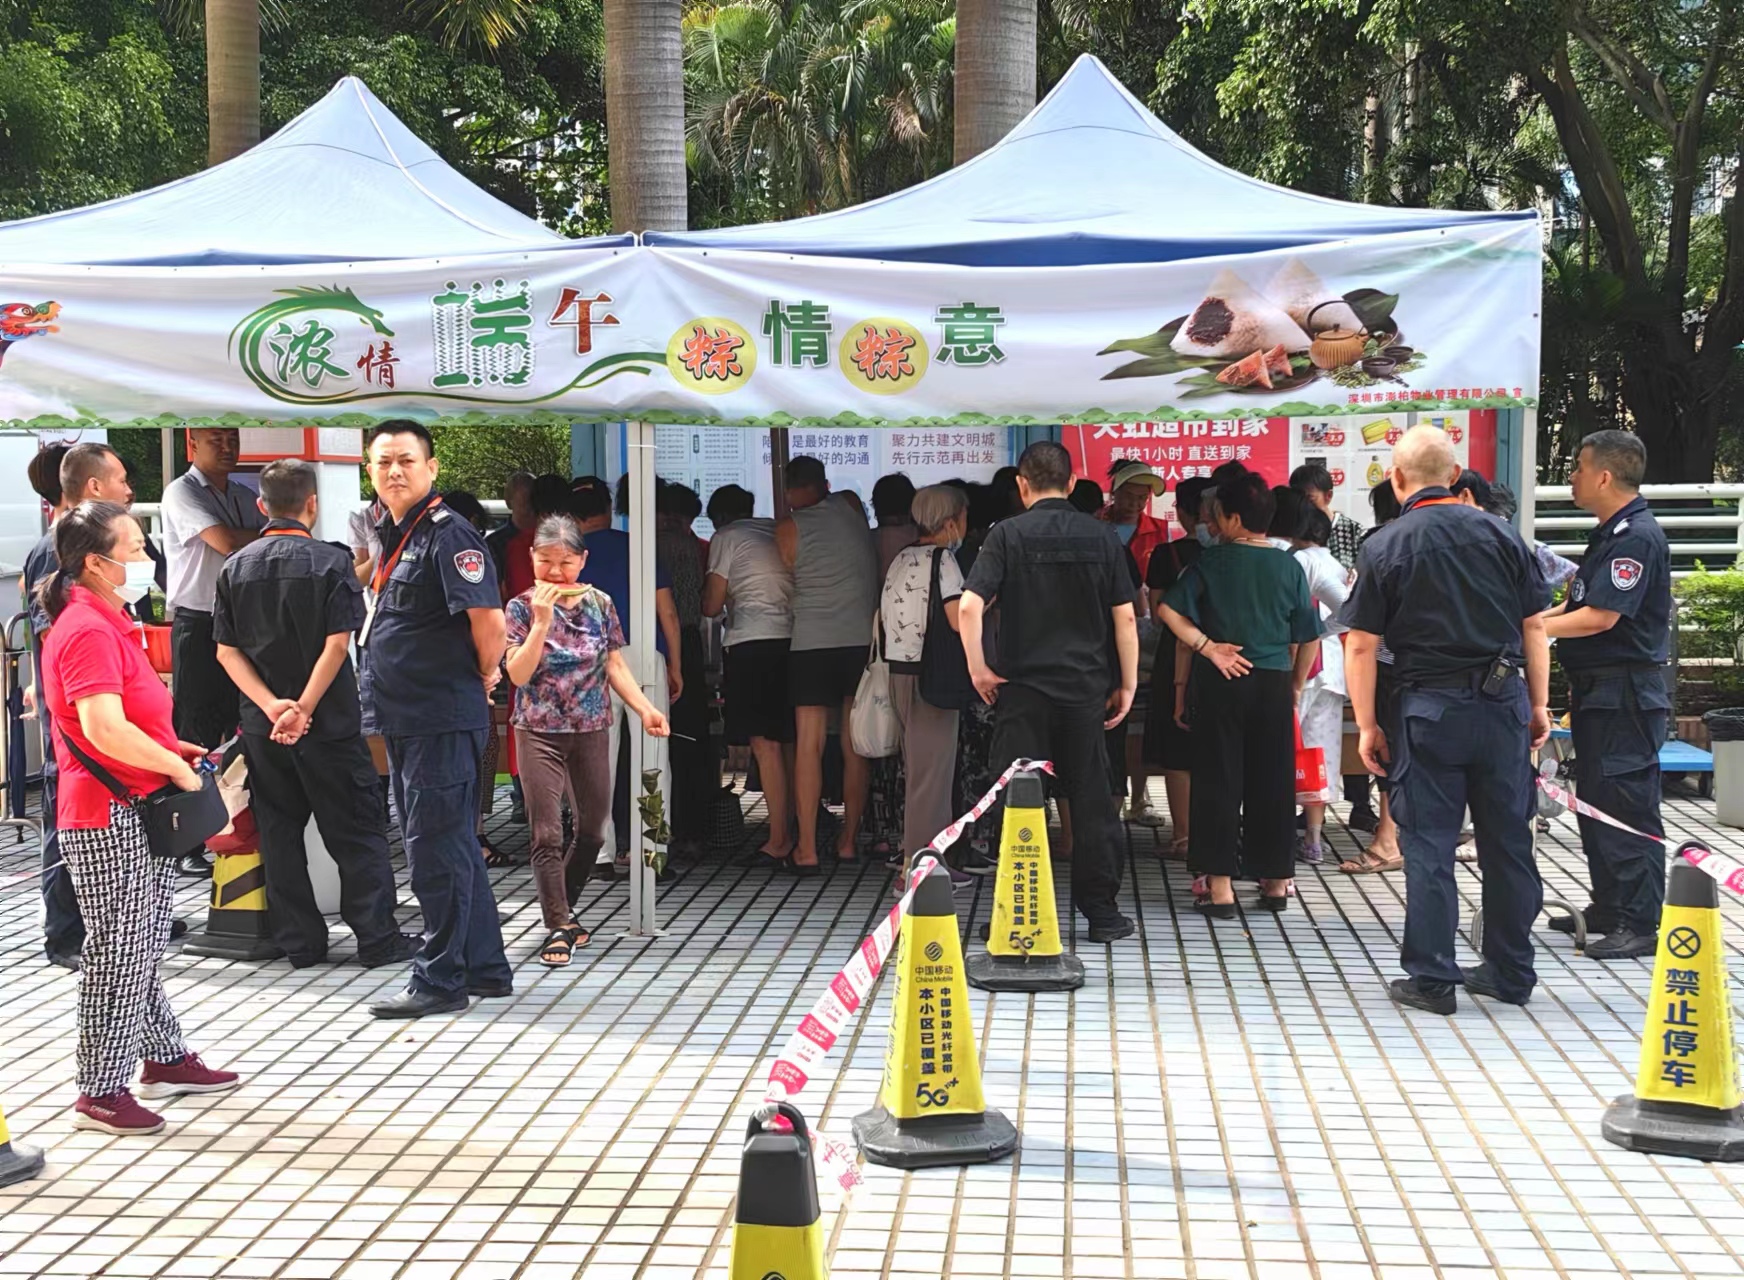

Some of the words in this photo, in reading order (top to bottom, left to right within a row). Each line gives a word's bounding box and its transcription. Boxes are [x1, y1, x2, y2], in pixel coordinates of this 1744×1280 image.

[762, 434, 869, 448] 陪是最好的教育
[891, 433, 996, 447] 聚力共建文明城
[891, 451, 995, 465] 先行示范再出发
[1110, 445, 1183, 462] 最快1小时
[1187, 445, 1252, 461] 直送到家
[914, 965, 954, 976] 中国移动
[919, 987, 936, 1076] 本小区已覆盖
[940, 987, 953, 1074] 中国移动光纤宽带
[1661, 968, 1700, 1087] 禁止停车
